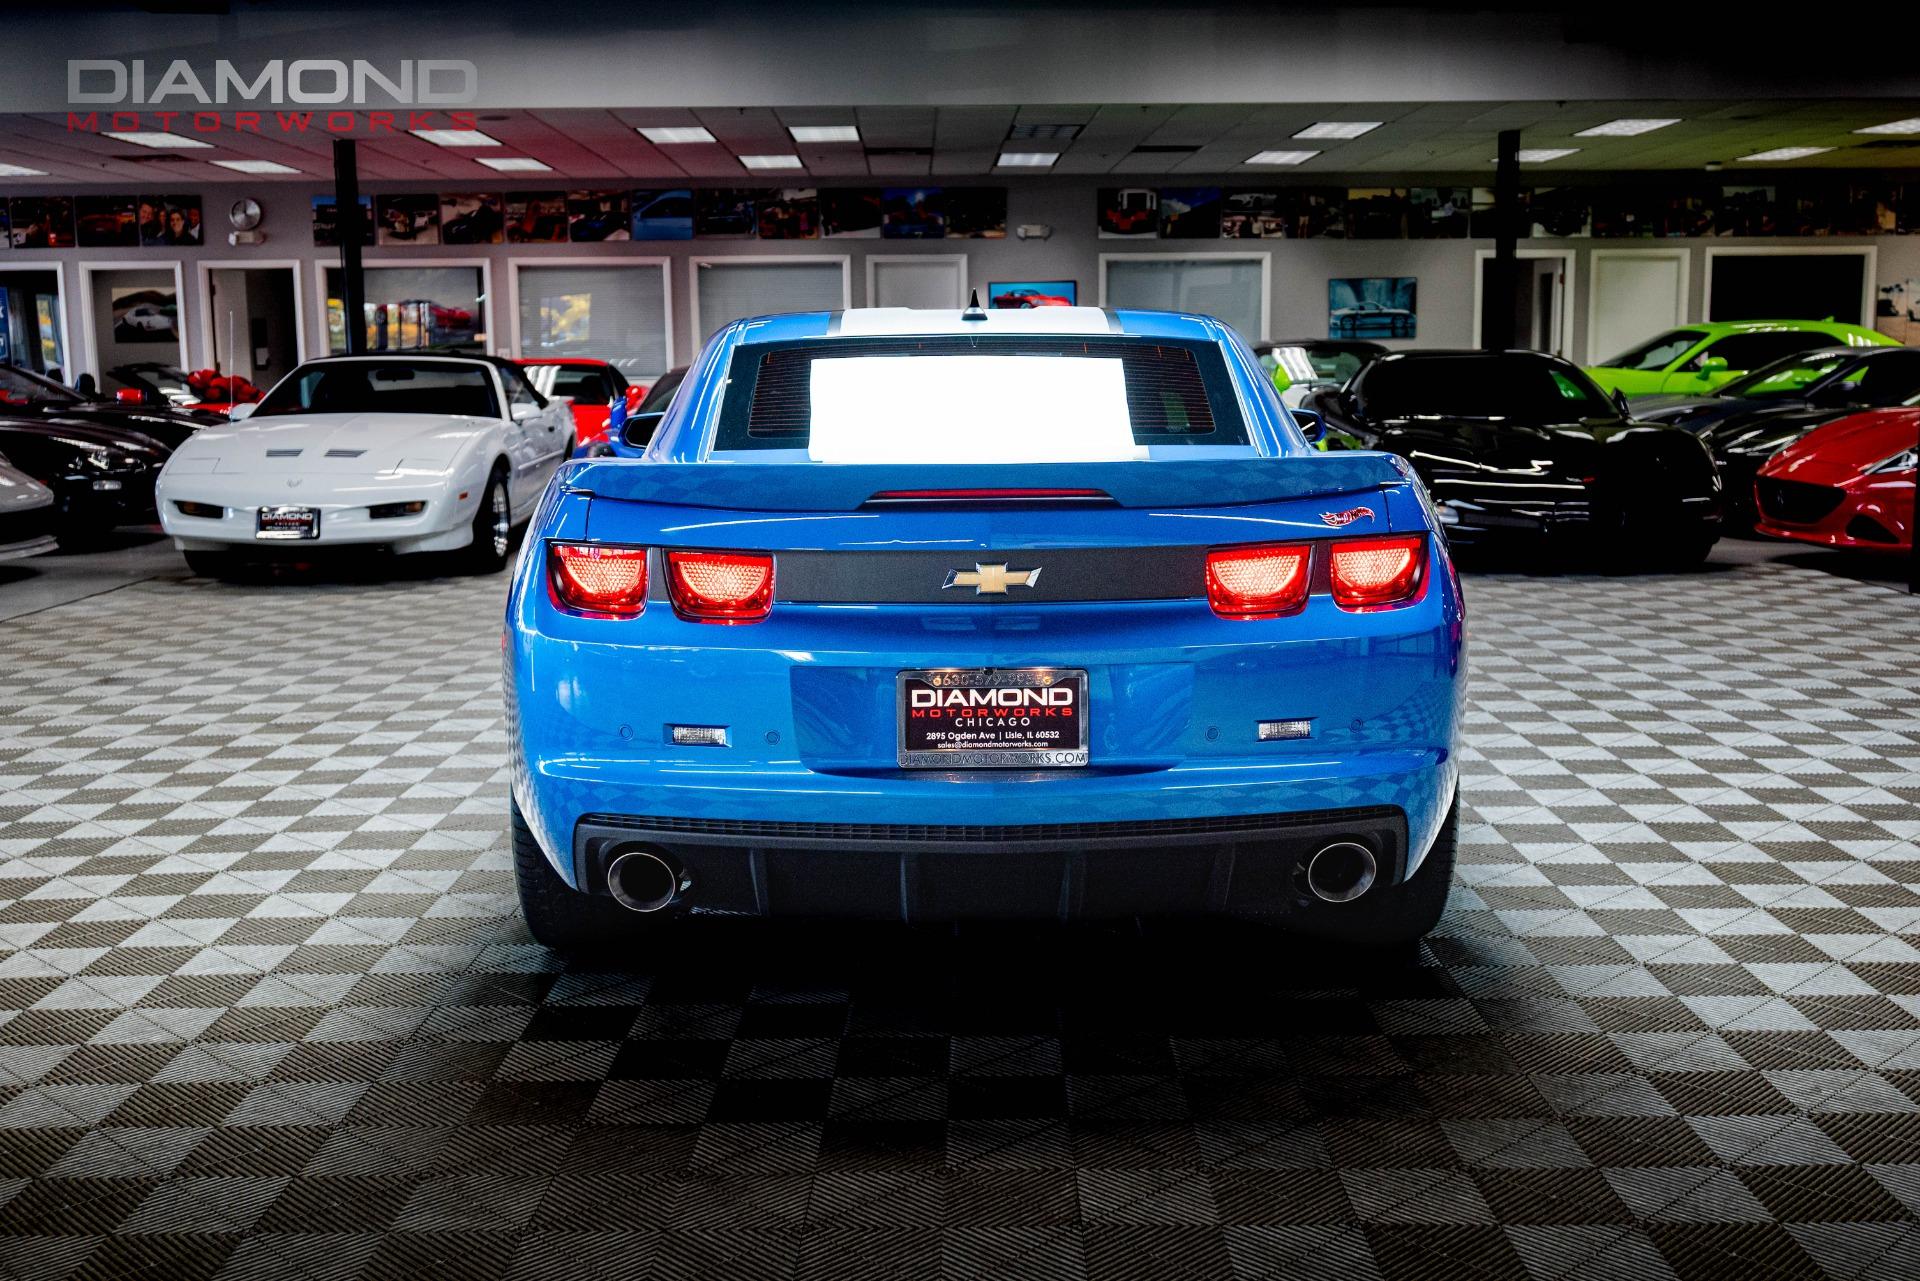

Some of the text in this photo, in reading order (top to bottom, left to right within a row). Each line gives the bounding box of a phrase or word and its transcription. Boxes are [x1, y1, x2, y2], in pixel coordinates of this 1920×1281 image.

[261, 512, 313, 521] DIAMOND
[911, 688, 1073, 708] DIAMOND
[911, 707, 1073, 719] MOTORWORKS
[955, 717, 1031, 727] CHICAGO
[926, 732, 946, 740] 2895
[947, 732, 977, 742] Ogden
[979, 731, 996, 740] Ave
[1027, 731, 1034, 739] IL
[1035, 731, 1060, 739] 60532
[937, 741, 1049, 749] sales@diamondmotorworks.com
[901, 752, 1087, 765] DIAMONDMOTORWORKS.COM
